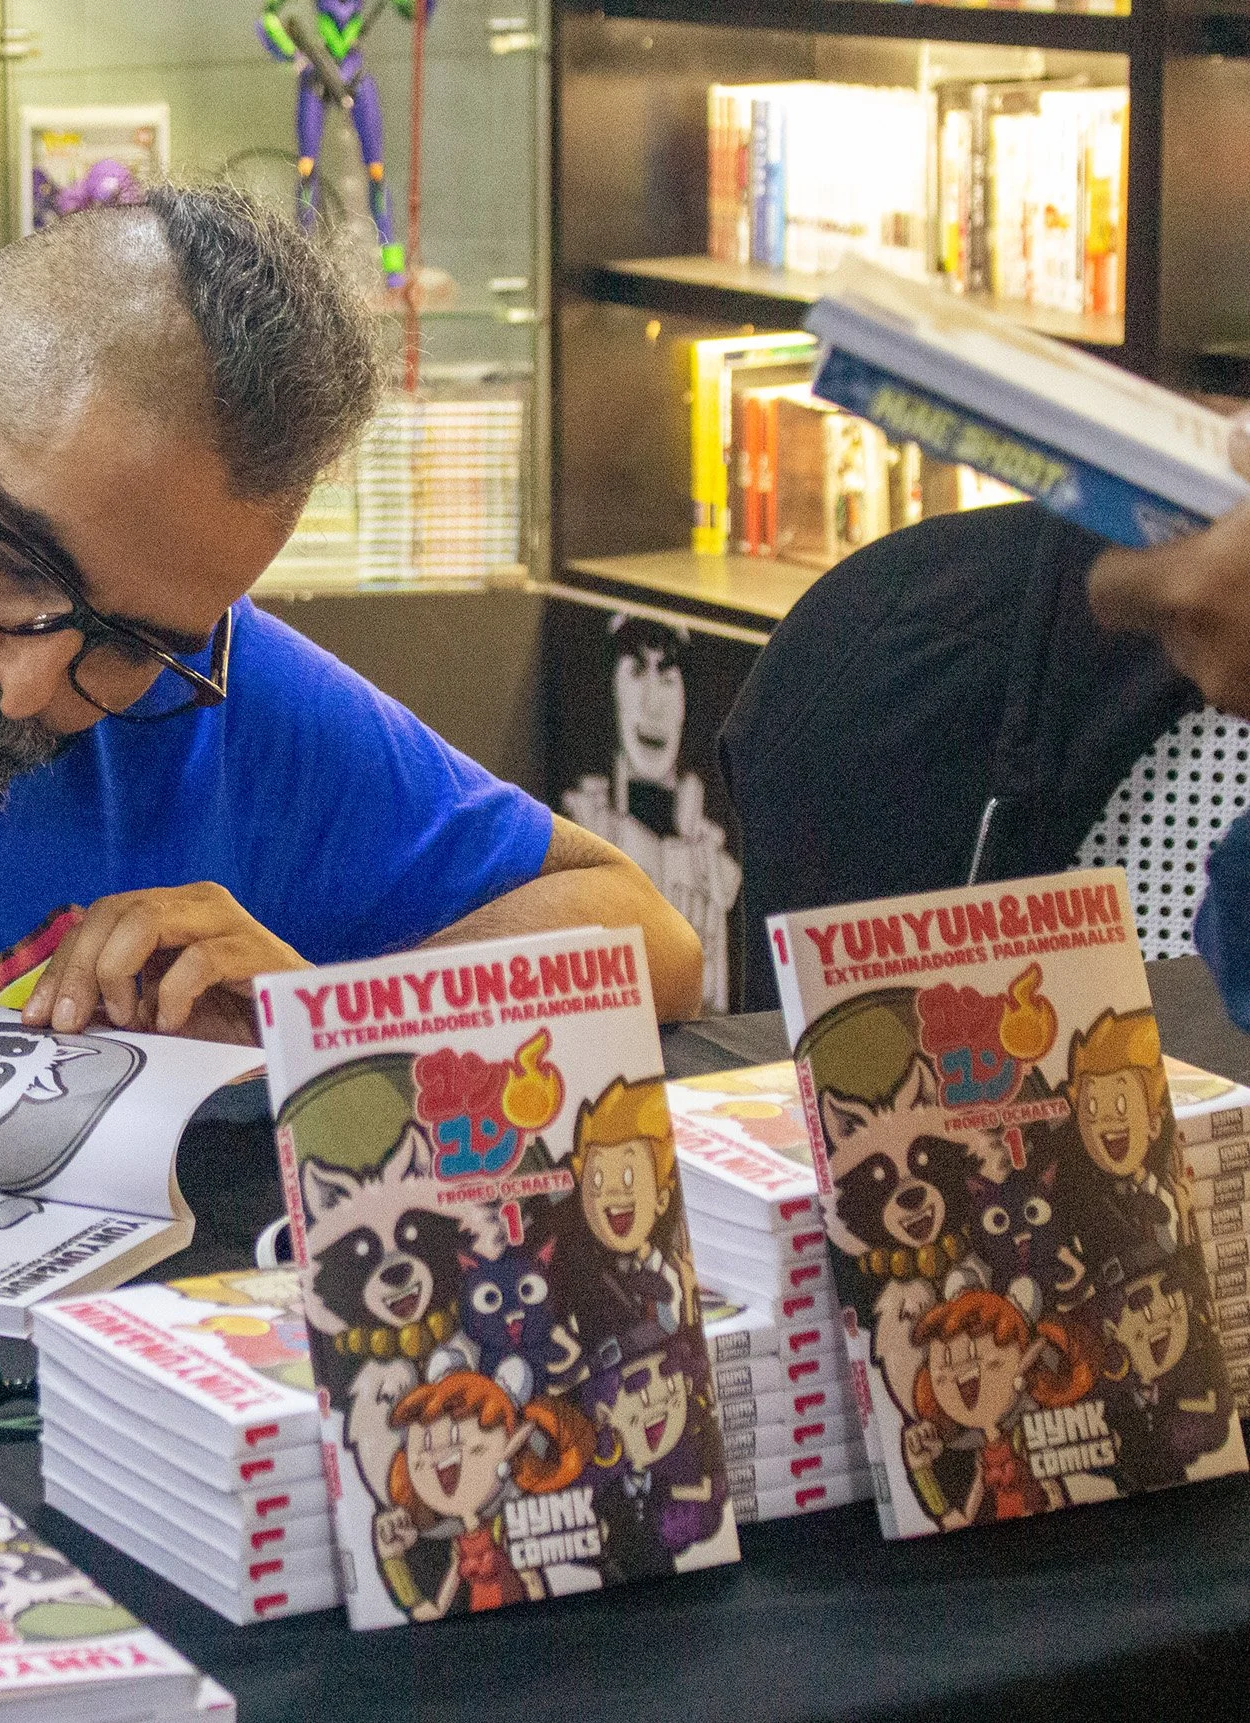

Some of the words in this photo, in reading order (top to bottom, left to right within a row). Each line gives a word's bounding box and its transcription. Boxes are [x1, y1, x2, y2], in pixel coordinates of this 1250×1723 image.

[805, 883, 1122, 967] YUNYUN&NUKI
[772, 928, 789, 966] 1
[823, 945, 988, 988] EXTERMINADORES
[994, 923, 1127, 961] PARANORMALES
[294, 943, 638, 1030] YUNYUN&NUKI
[258, 989, 273, 1027] 1
[313, 1010, 495, 1052] EXTERMINADORES
[500, 988, 642, 1022] PARANORMALES
[1004, 1128, 1026, 1168] 1
[780, 1199, 812, 1222] 1
[501, 1203, 522, 1242] 1
[792, 1232, 824, 1253] 1
[790, 1265, 822, 1288] 1
[782, 1296, 815, 1318] 1
[788, 1330, 821, 1353] 1
[788, 1360, 820, 1383] 1
[794, 1392, 826, 1416] 1
[244, 1423, 280, 1447] 1
[793, 1423, 825, 1446] 1
[240, 1458, 275, 1482] 1
[790, 1456, 823, 1479] 1
[1027, 1440, 1120, 1482] COMICS
[255, 1495, 290, 1517] 1
[795, 1486, 827, 1508] 1
[250, 1528, 285, 1551] 1
[510, 1527, 604, 1570] COMICS
[249, 1559, 284, 1581] 1
[253, 1593, 288, 1616] 1
